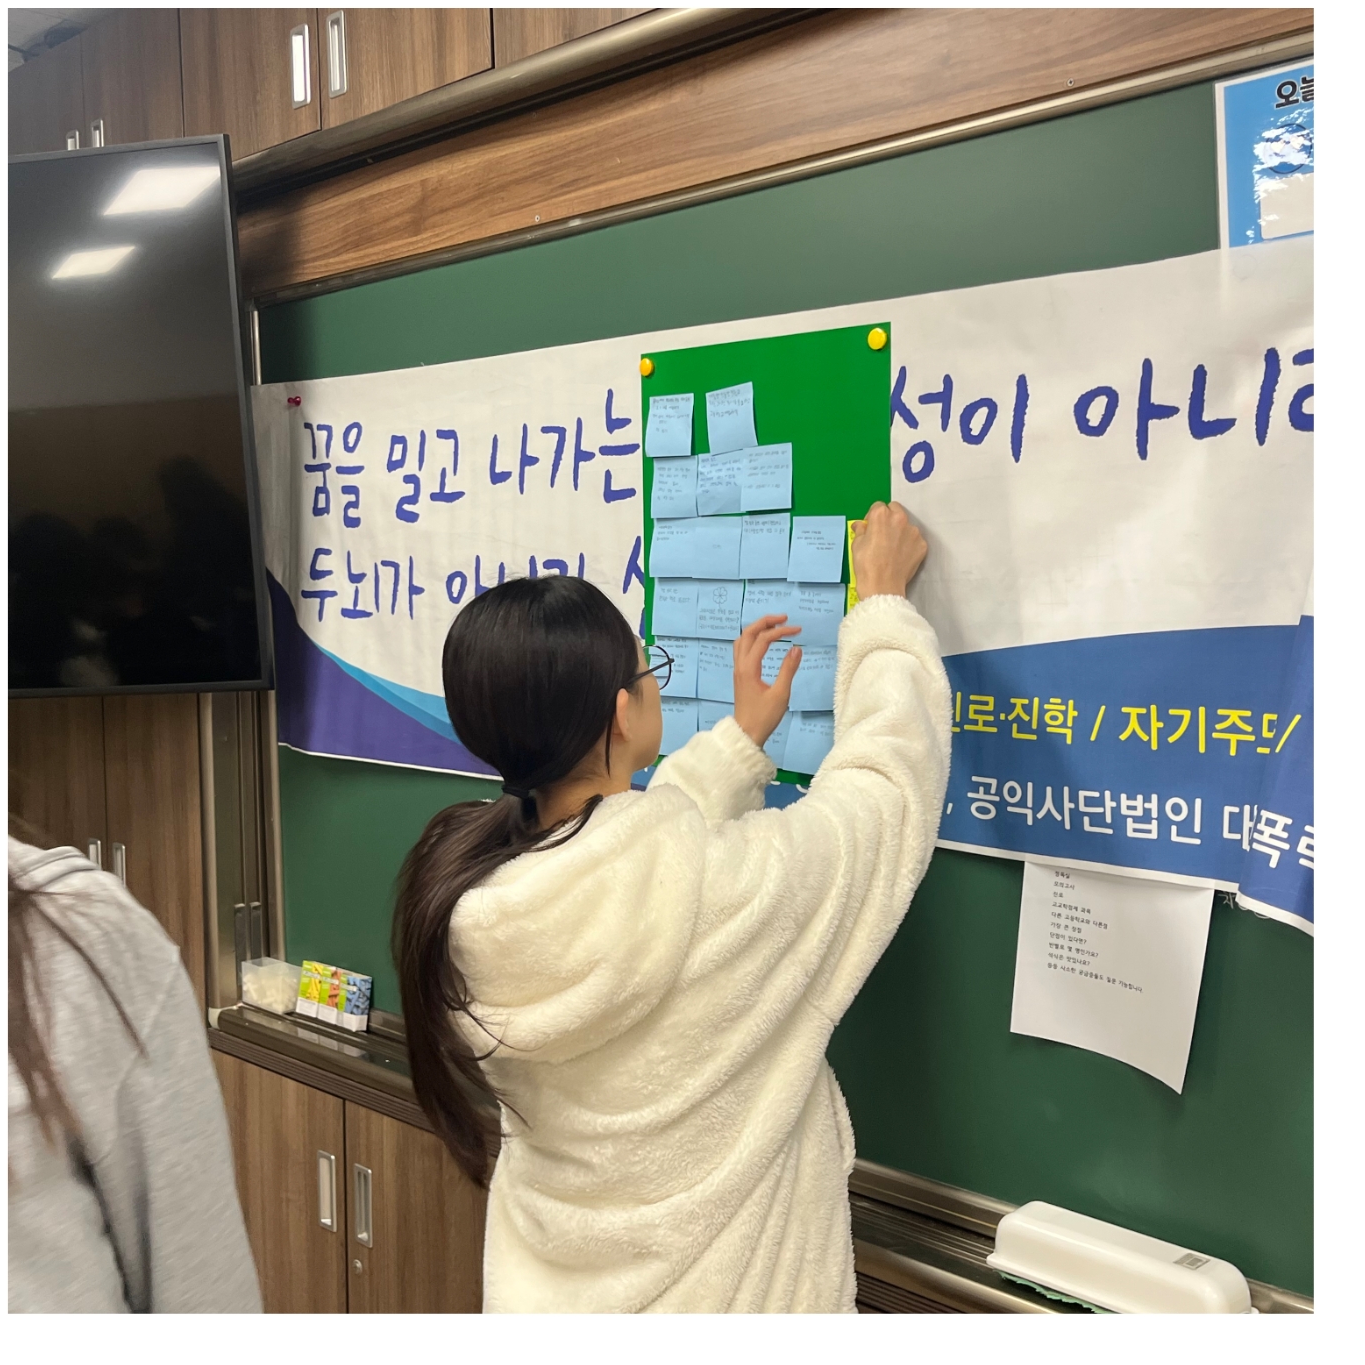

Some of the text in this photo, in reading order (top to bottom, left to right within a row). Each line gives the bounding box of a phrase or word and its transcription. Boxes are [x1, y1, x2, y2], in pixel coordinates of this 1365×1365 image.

[302, 422, 364, 528] 꿈을
[387, 429, 465, 522] 밀고
[490, 389, 640, 504] 나가는
[302, 548, 425, 622] 두뇌가
[967, 775, 1202, 845] 공익사단법인
[1053, 881, 1075, 890] 모의고사
